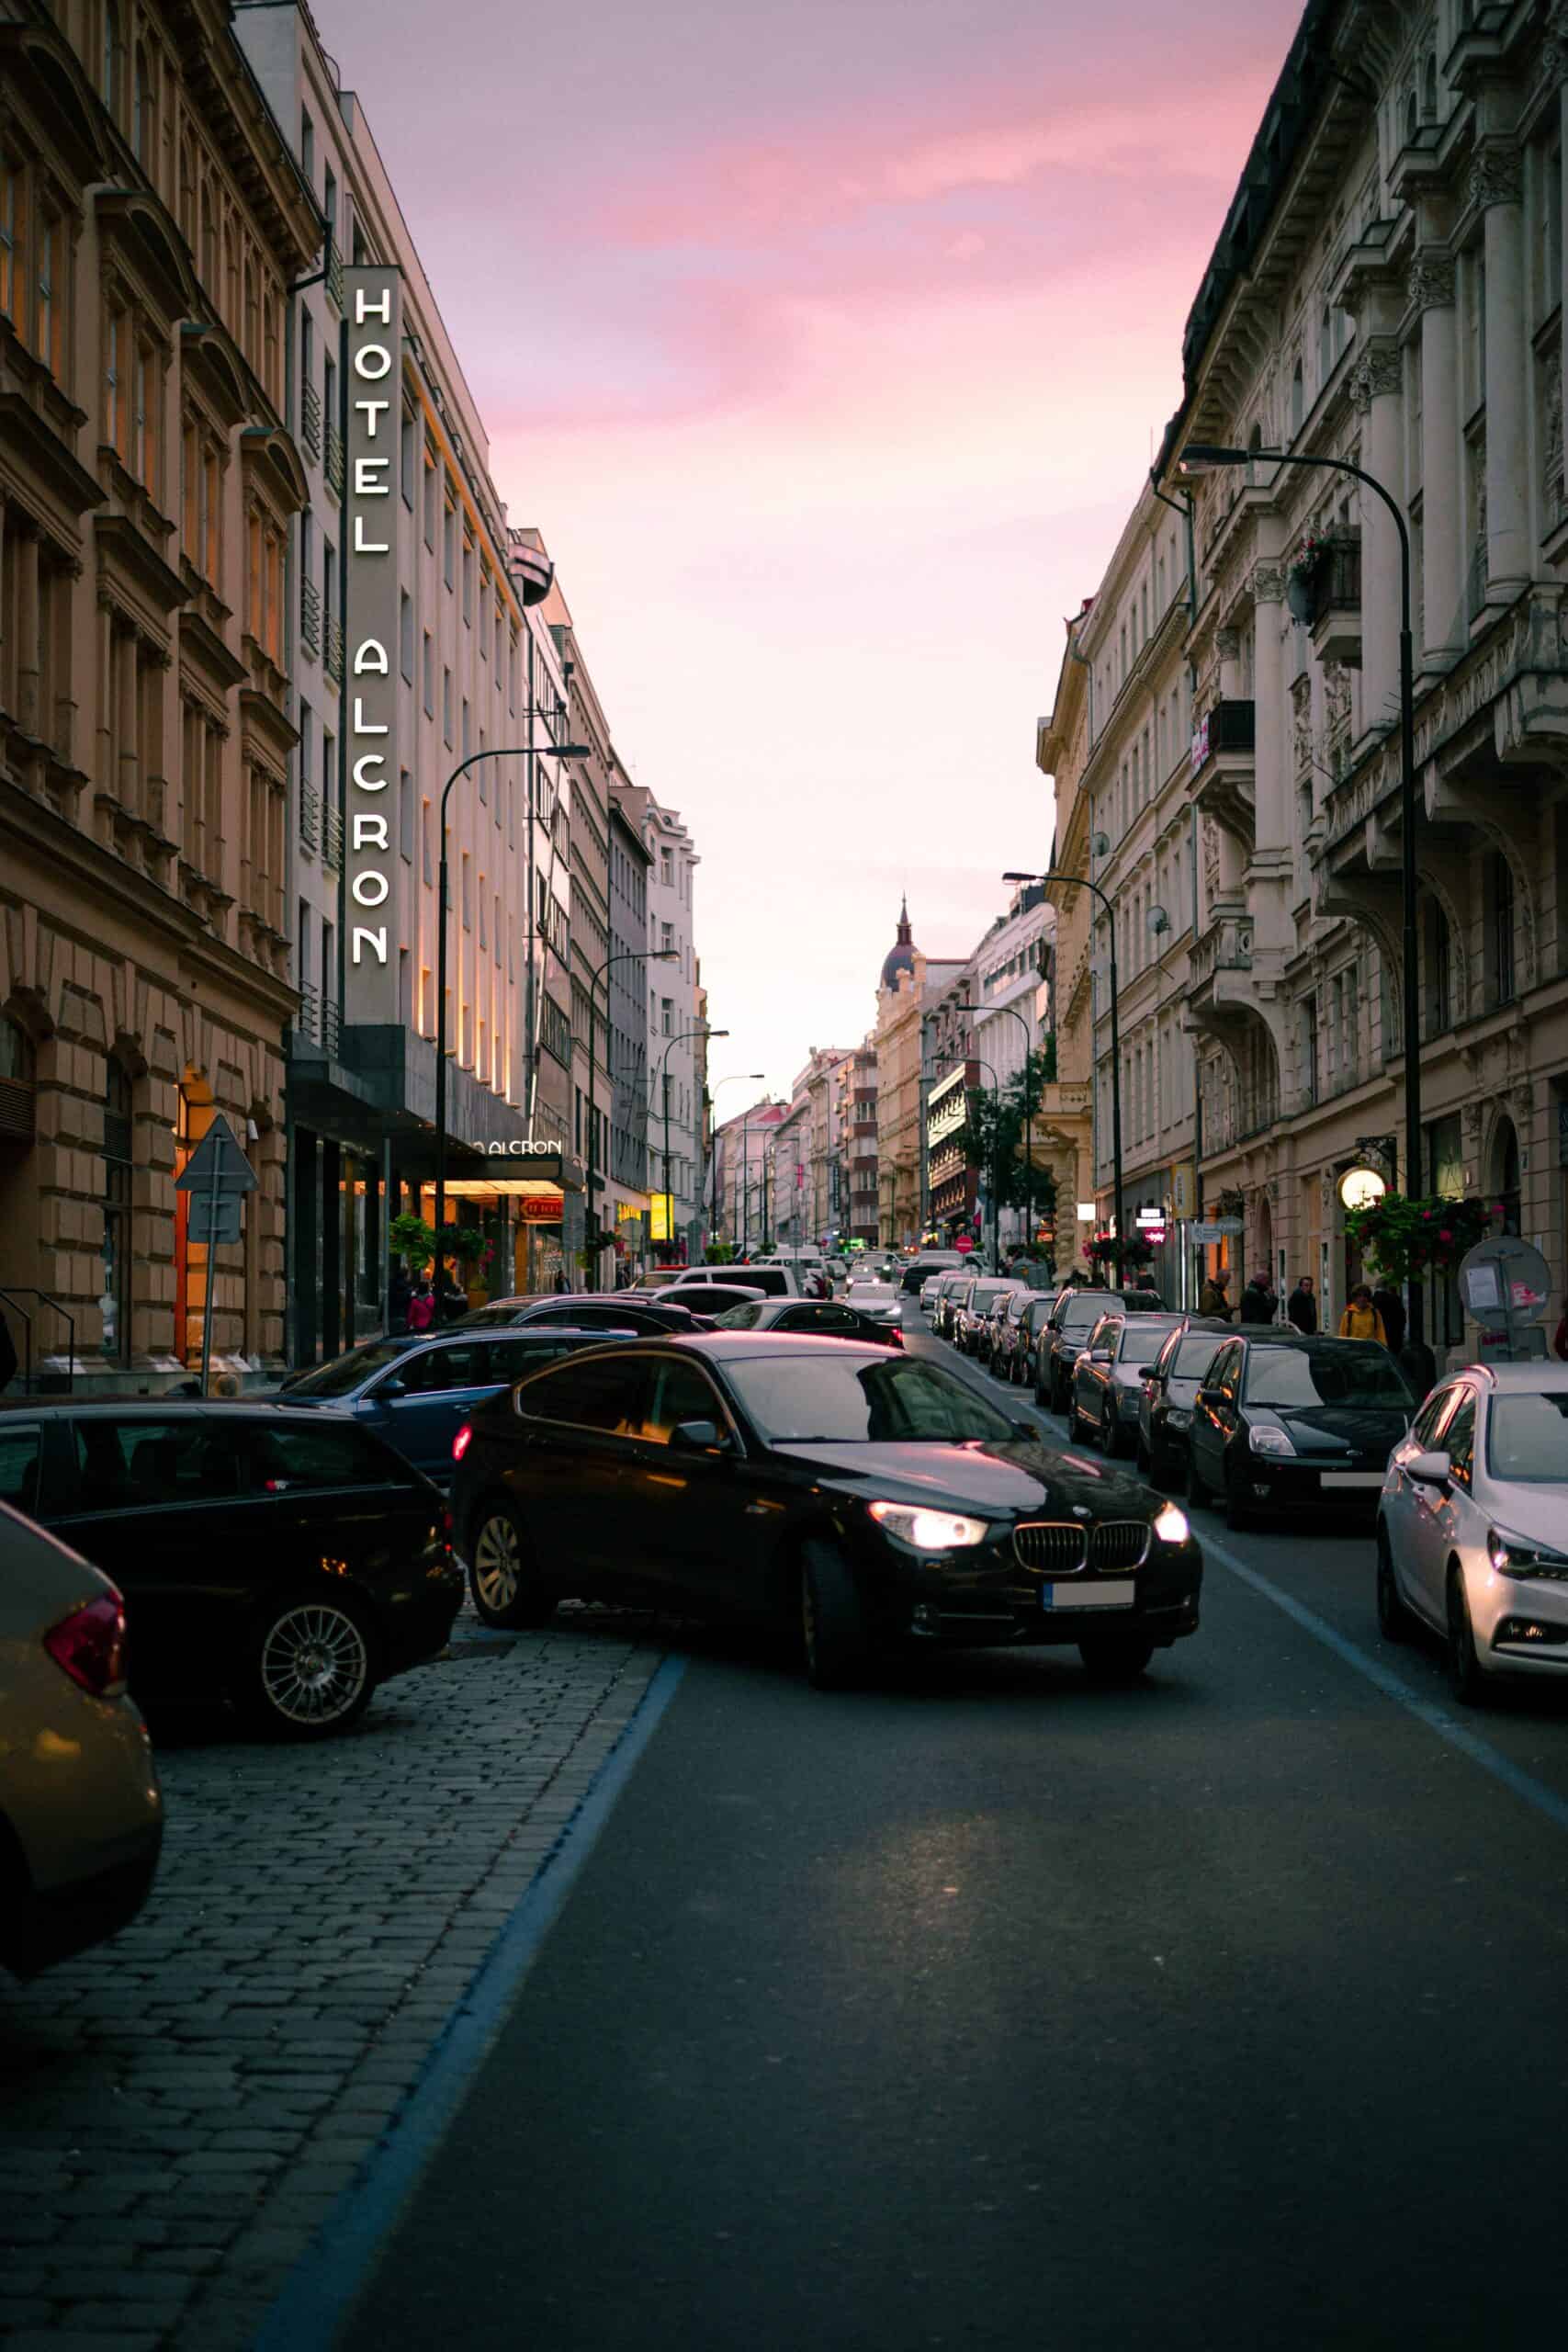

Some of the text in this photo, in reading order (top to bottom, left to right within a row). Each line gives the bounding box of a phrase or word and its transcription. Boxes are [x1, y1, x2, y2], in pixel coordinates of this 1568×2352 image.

[351, 287, 392, 964] HOTEL ALCRON
[490, 1139, 562, 1155] ALCRON
